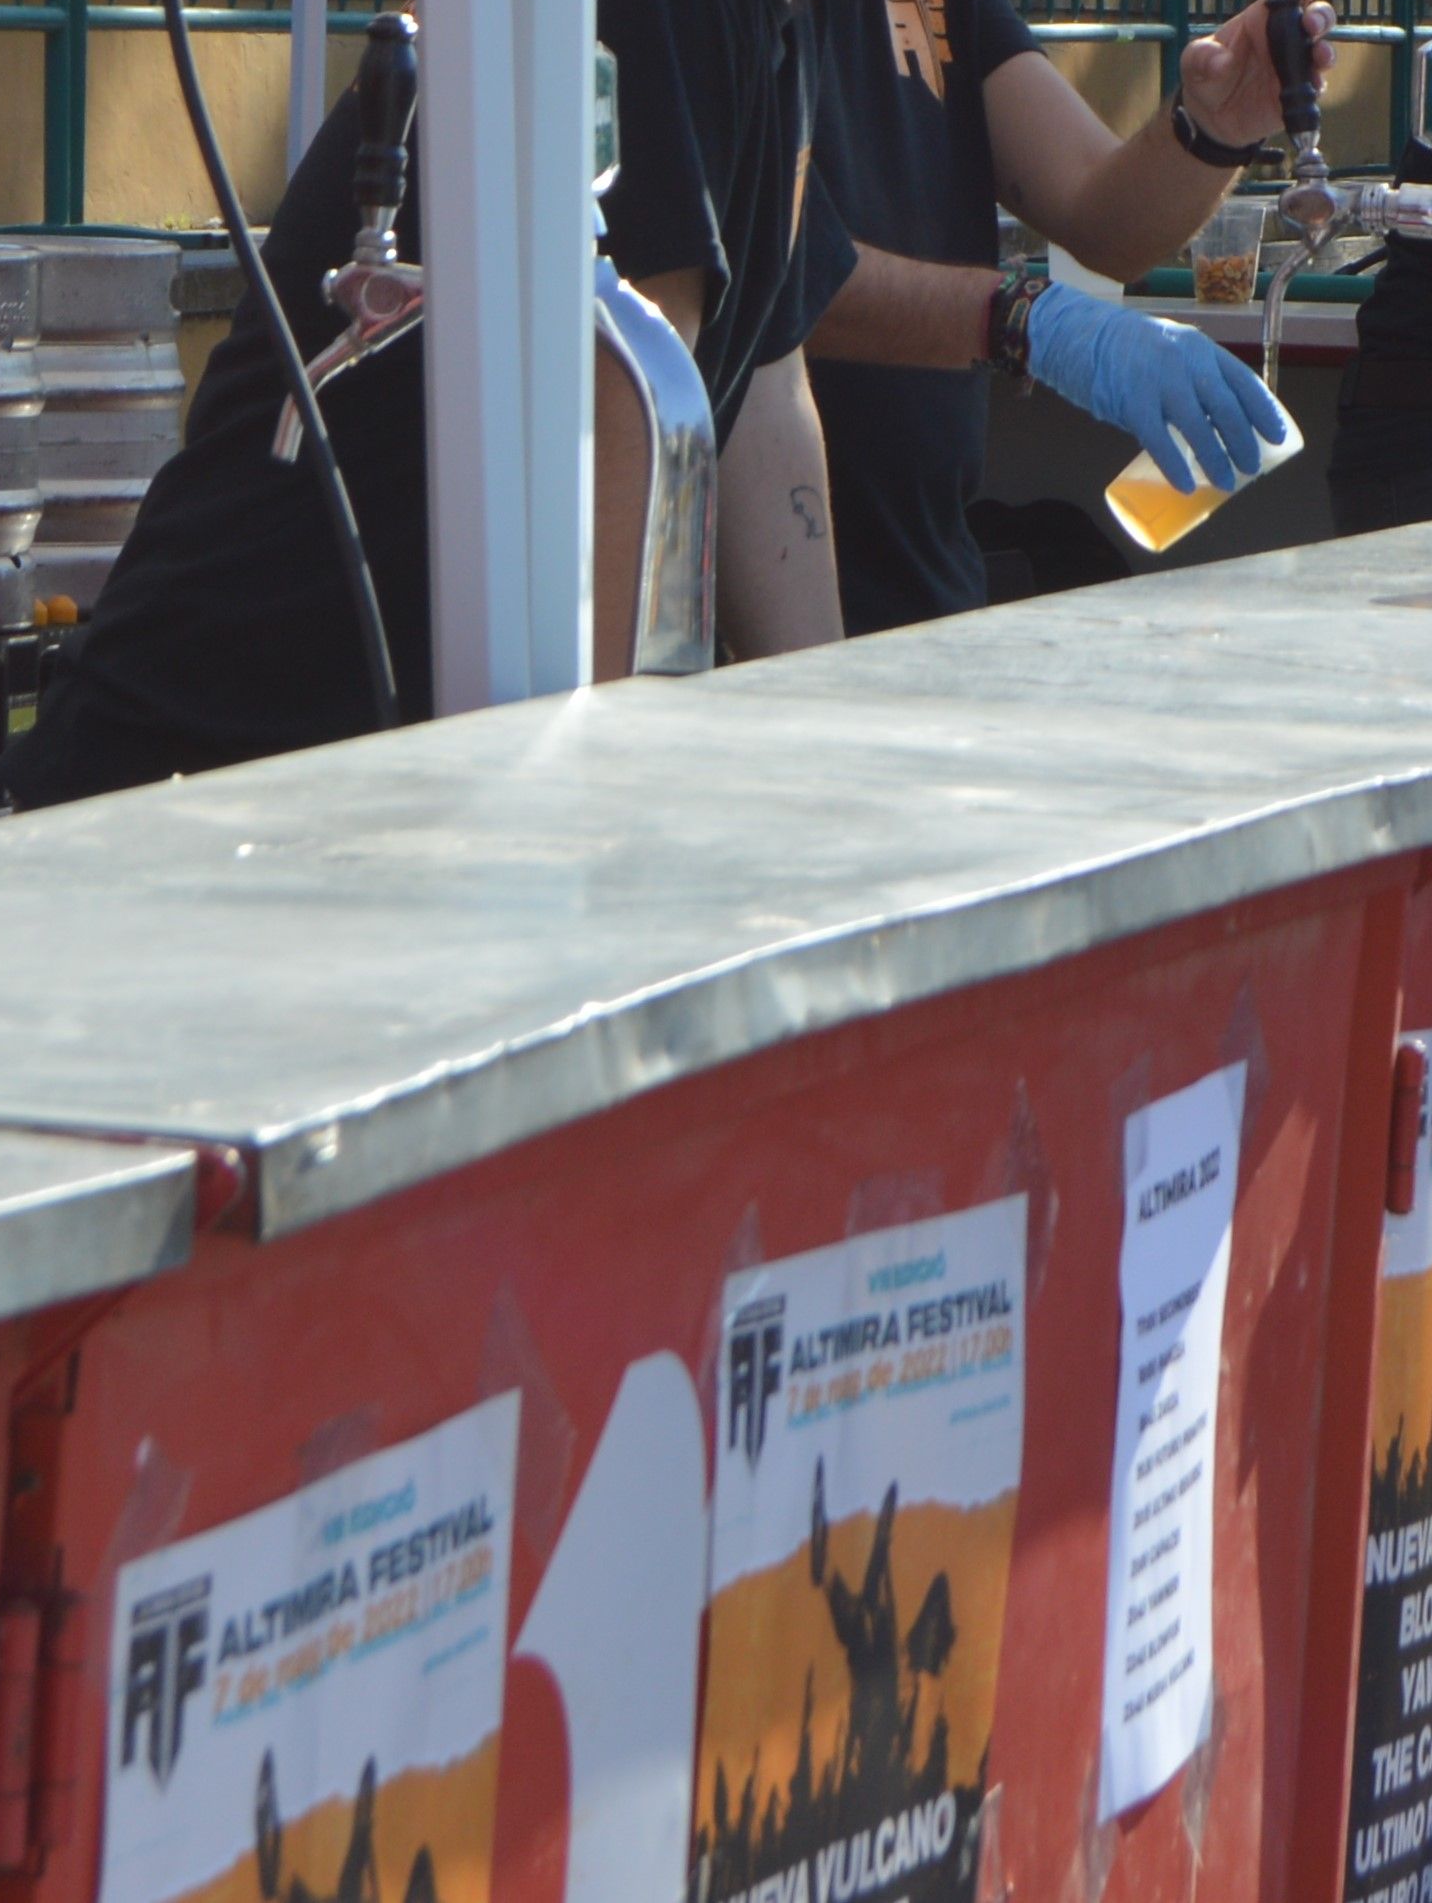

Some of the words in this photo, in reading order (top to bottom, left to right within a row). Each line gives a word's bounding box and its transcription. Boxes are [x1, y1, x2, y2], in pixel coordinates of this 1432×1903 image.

[1137, 1164, 1197, 1224] ALTIMIRA
[790, 1309, 901, 1376] ALTIMIRA
[906, 1277, 1012, 1343] FESTIVAL
[217, 1557, 361, 1666] ALTIMIRA
[369, 1494, 494, 1592] FESTIVAL
[1373, 1732, 1415, 1800] THE
[816, 1789, 957, 1903] VULCANO
[1354, 1800, 1426, 1876] ULTIMO
